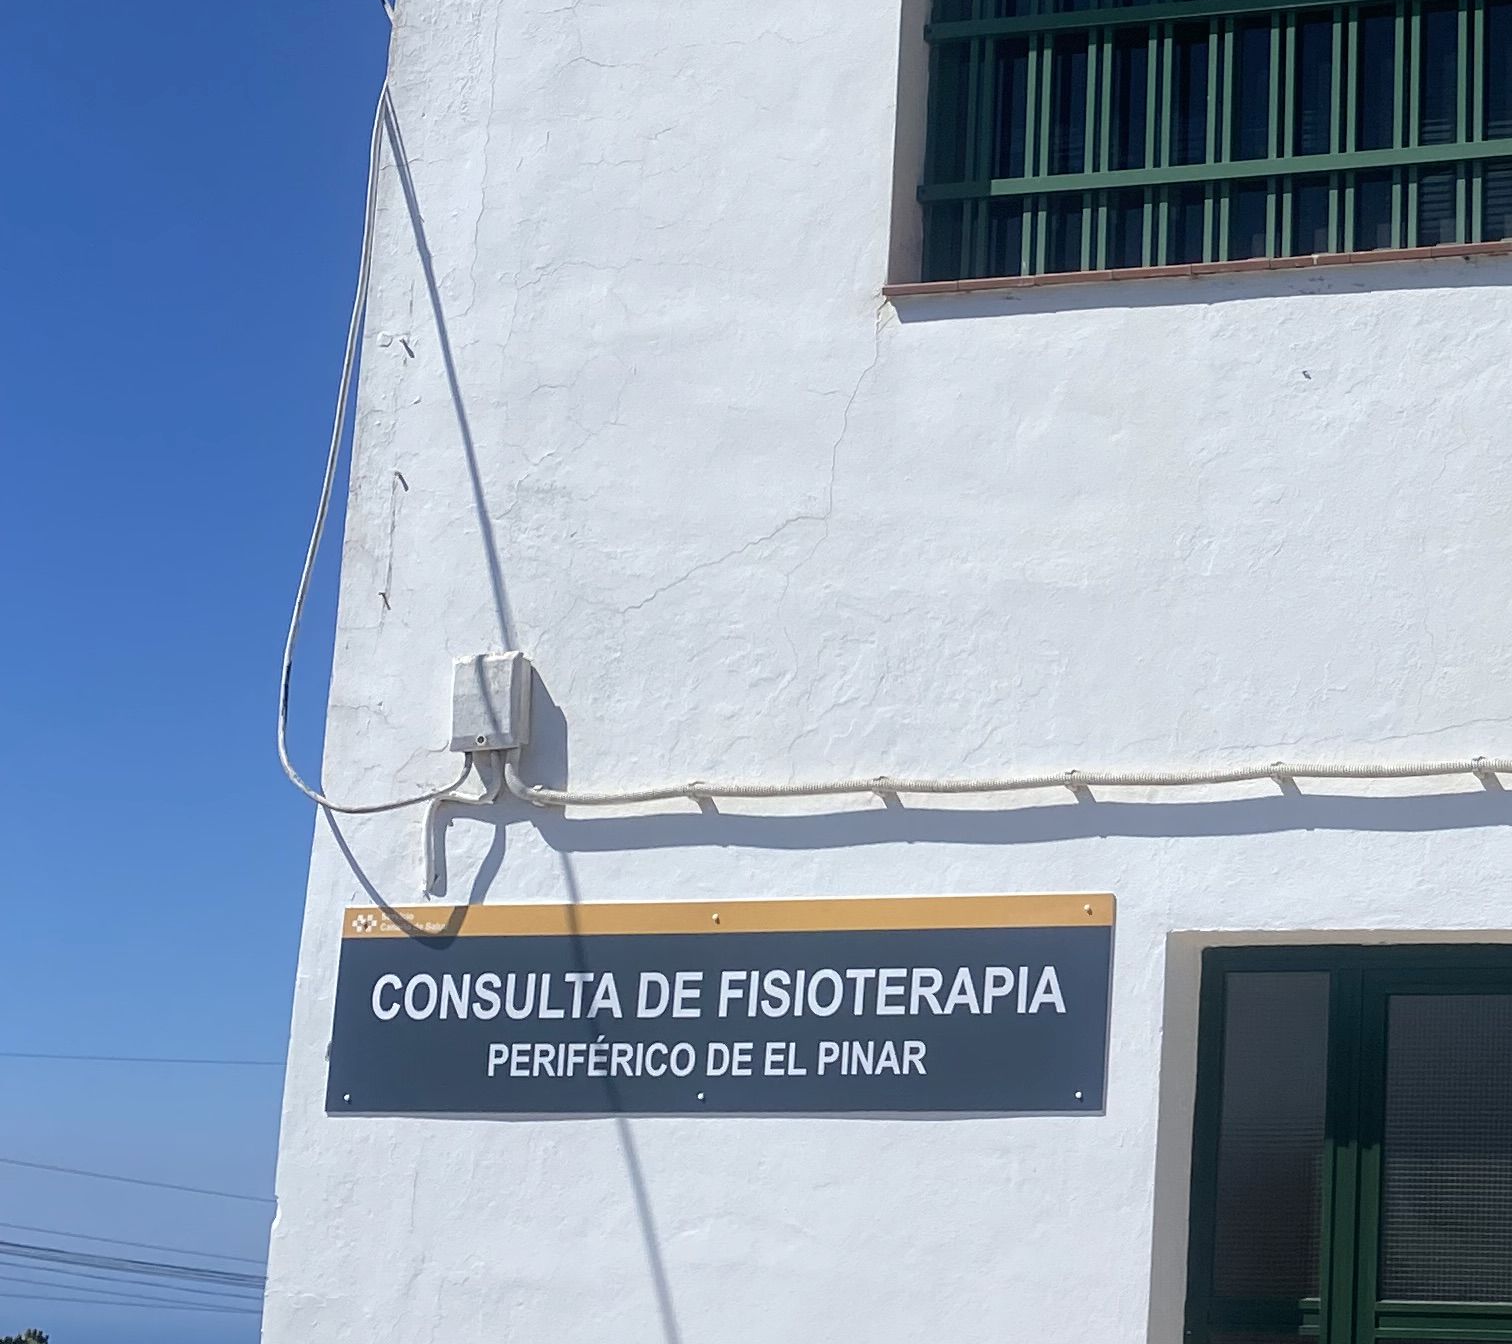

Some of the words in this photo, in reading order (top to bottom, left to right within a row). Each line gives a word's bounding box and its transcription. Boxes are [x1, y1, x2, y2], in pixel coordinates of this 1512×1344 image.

[371, 972, 623, 1020] CONSULTA
[636, 971, 704, 1018] DE
[718, 965, 1067, 1018] FISIOTERAPIA
[487, 1034, 696, 1077] PERIFÉRICO
[706, 1042, 754, 1076] DE
[764, 1041, 807, 1076] EL
[817, 1040, 927, 1075] PINAR
